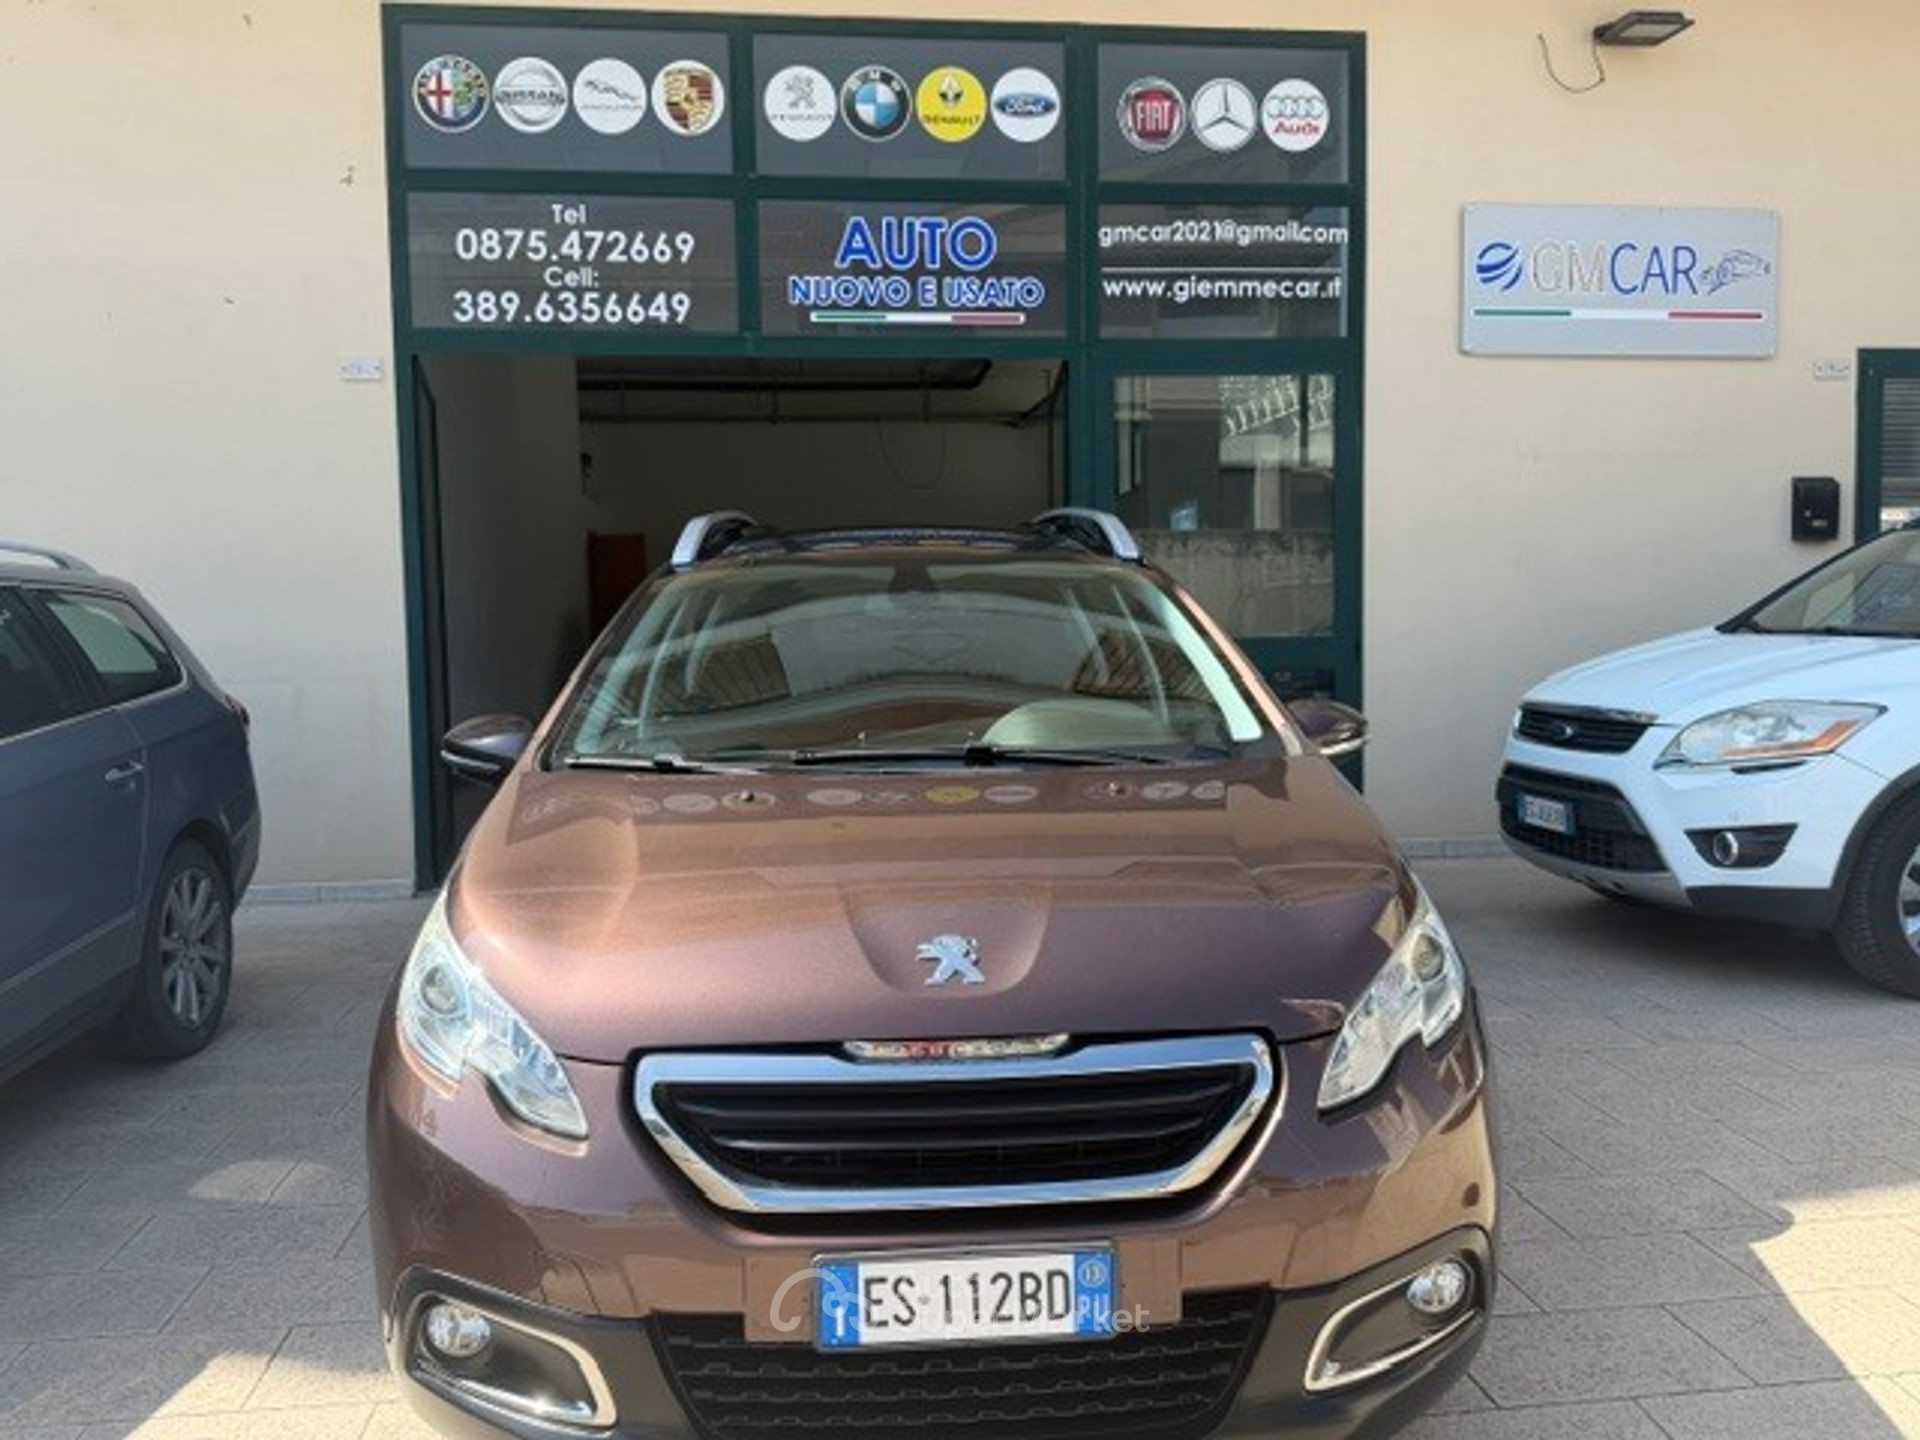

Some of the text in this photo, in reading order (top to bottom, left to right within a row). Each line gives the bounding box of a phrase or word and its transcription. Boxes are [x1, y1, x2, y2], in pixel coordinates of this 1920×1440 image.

[1135, 101, 1172, 131] FIAT
[1274, 121, 1321, 136] Audi
[551, 204, 587, 225] Tel
[454, 228, 695, 263] 0875.472669
[835, 216, 998, 270] AUTO
[1098, 219, 1348, 247] gmcar2021@gmail.com
[543, 266, 600, 288] Cell:
[1102, 275, 1343, 303] www.giemmecar.it
[452, 289, 692, 324] 389.6356649
[788, 276, 1046, 309] NUOVO E USATO
